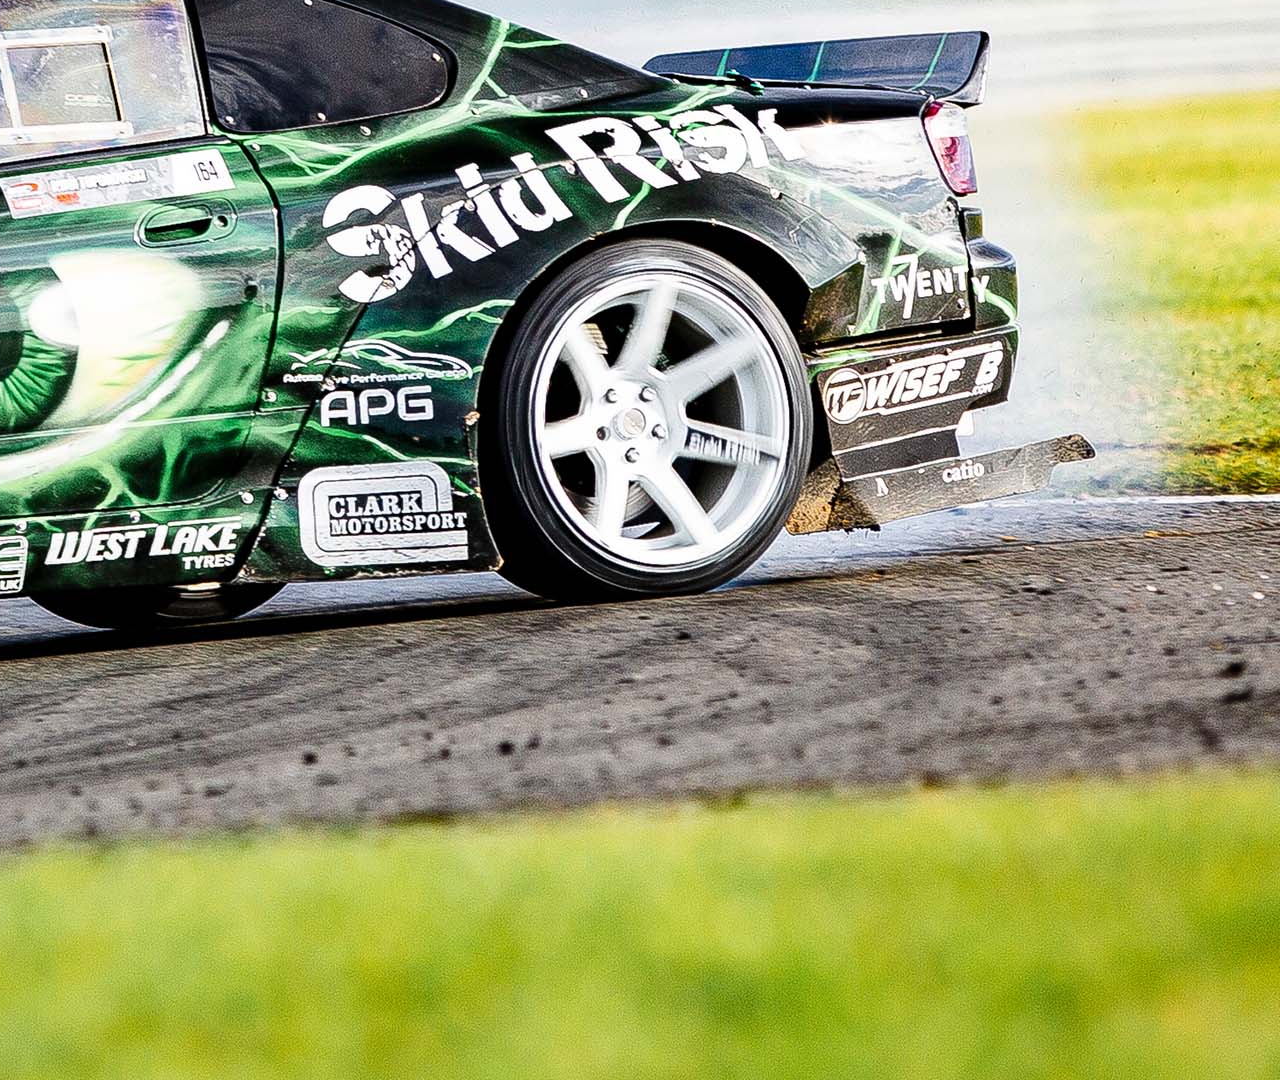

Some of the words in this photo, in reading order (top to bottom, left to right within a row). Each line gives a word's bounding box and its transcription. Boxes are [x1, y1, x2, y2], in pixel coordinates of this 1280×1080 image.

[192, 160, 219, 182] 164
[322, 150, 574, 304] Skid
[320, 385, 434, 427] APG
[329, 495, 422, 518] CLARK
[329, 513, 468, 536] MOTORSPORT
[44, 523, 158, 565] WEST
[148, 516, 243, 557] LAKE
[181, 553, 236, 570] TYRES
